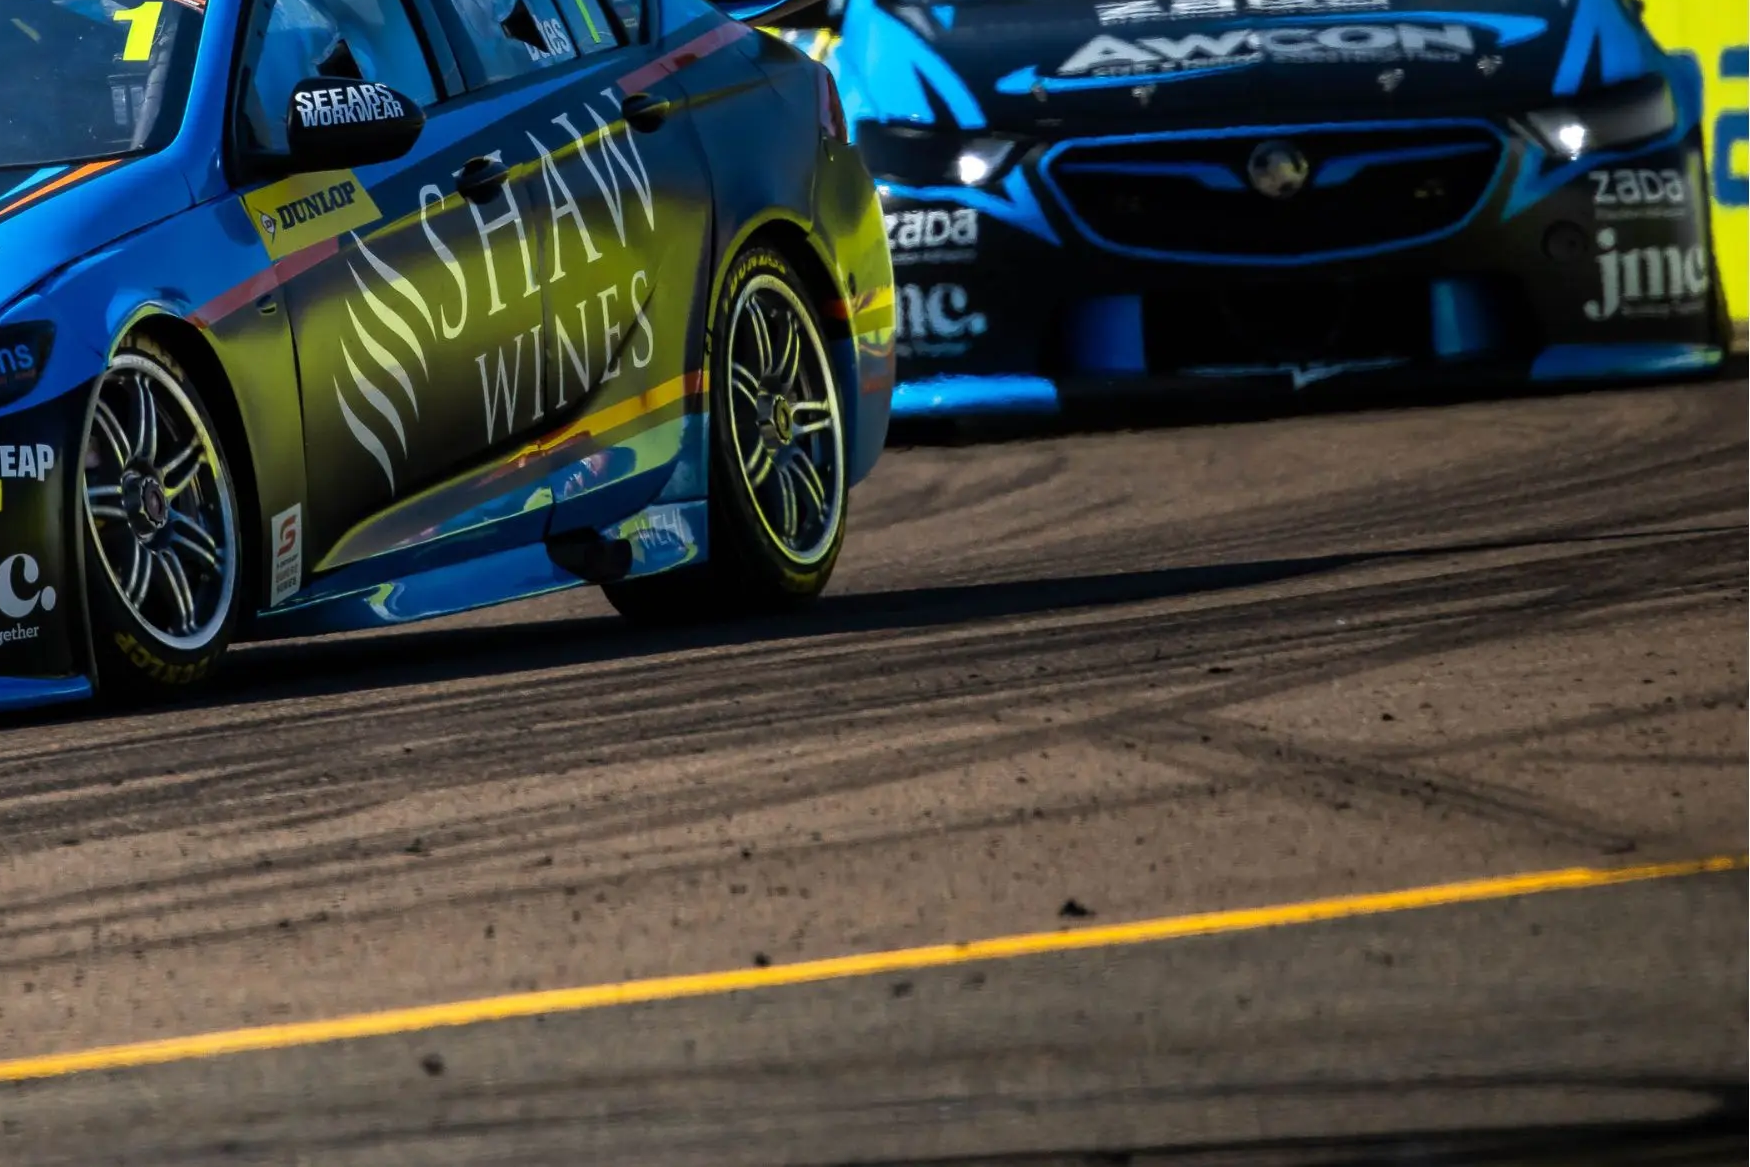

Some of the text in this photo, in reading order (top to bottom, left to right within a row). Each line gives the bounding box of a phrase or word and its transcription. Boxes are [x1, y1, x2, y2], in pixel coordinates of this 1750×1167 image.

[113, 1, 164, 61] 1
[1057, 24, 1476, 76] AWCON
[299, 99, 405, 128] WORKWEAR
[275, 180, 356, 231] DUNLOP
[419, 86, 655, 340] SHAW
[474, 269, 654, 445] WINES
